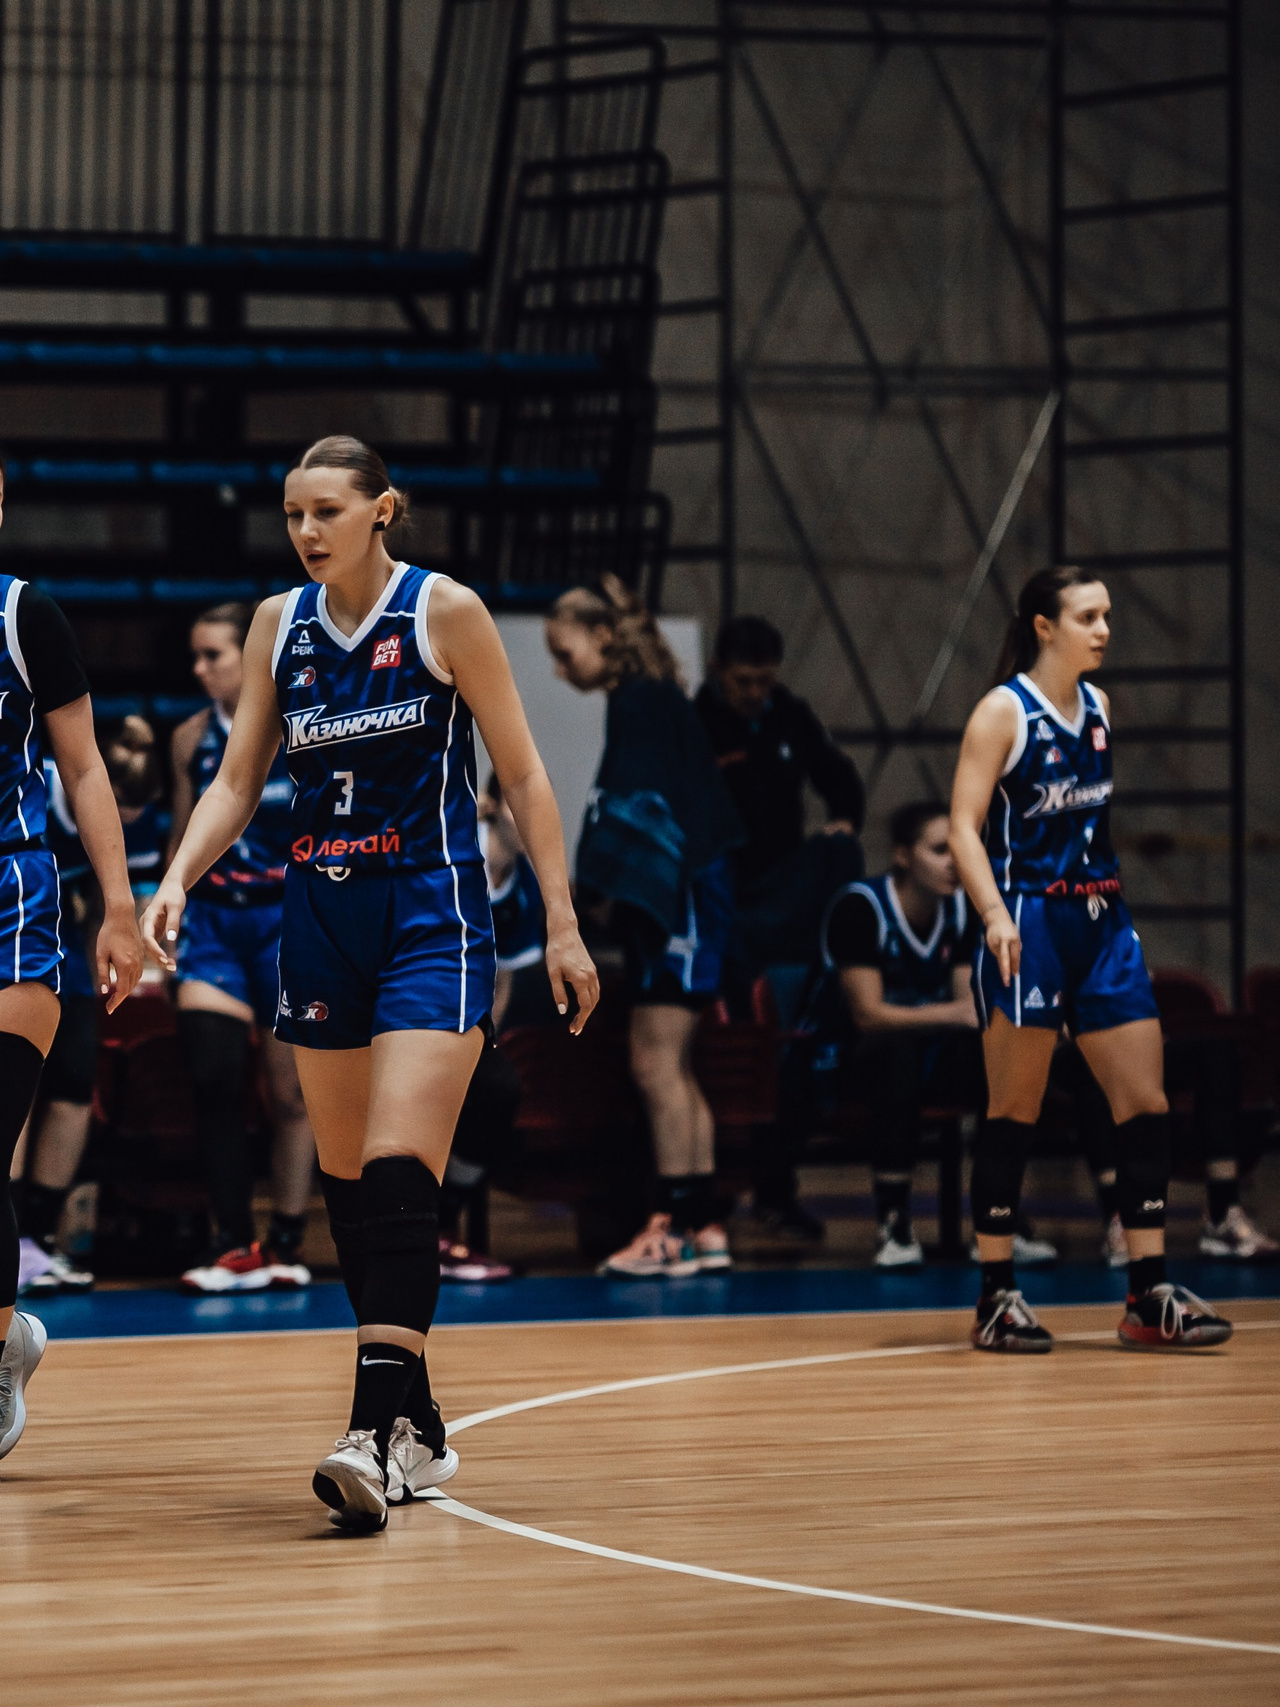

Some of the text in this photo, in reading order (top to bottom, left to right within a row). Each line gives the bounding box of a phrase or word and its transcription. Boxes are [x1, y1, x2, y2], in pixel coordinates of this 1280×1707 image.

[375, 638, 400, 655] FON
[372, 652, 399, 668] BET
[333, 771, 354, 815] 3
